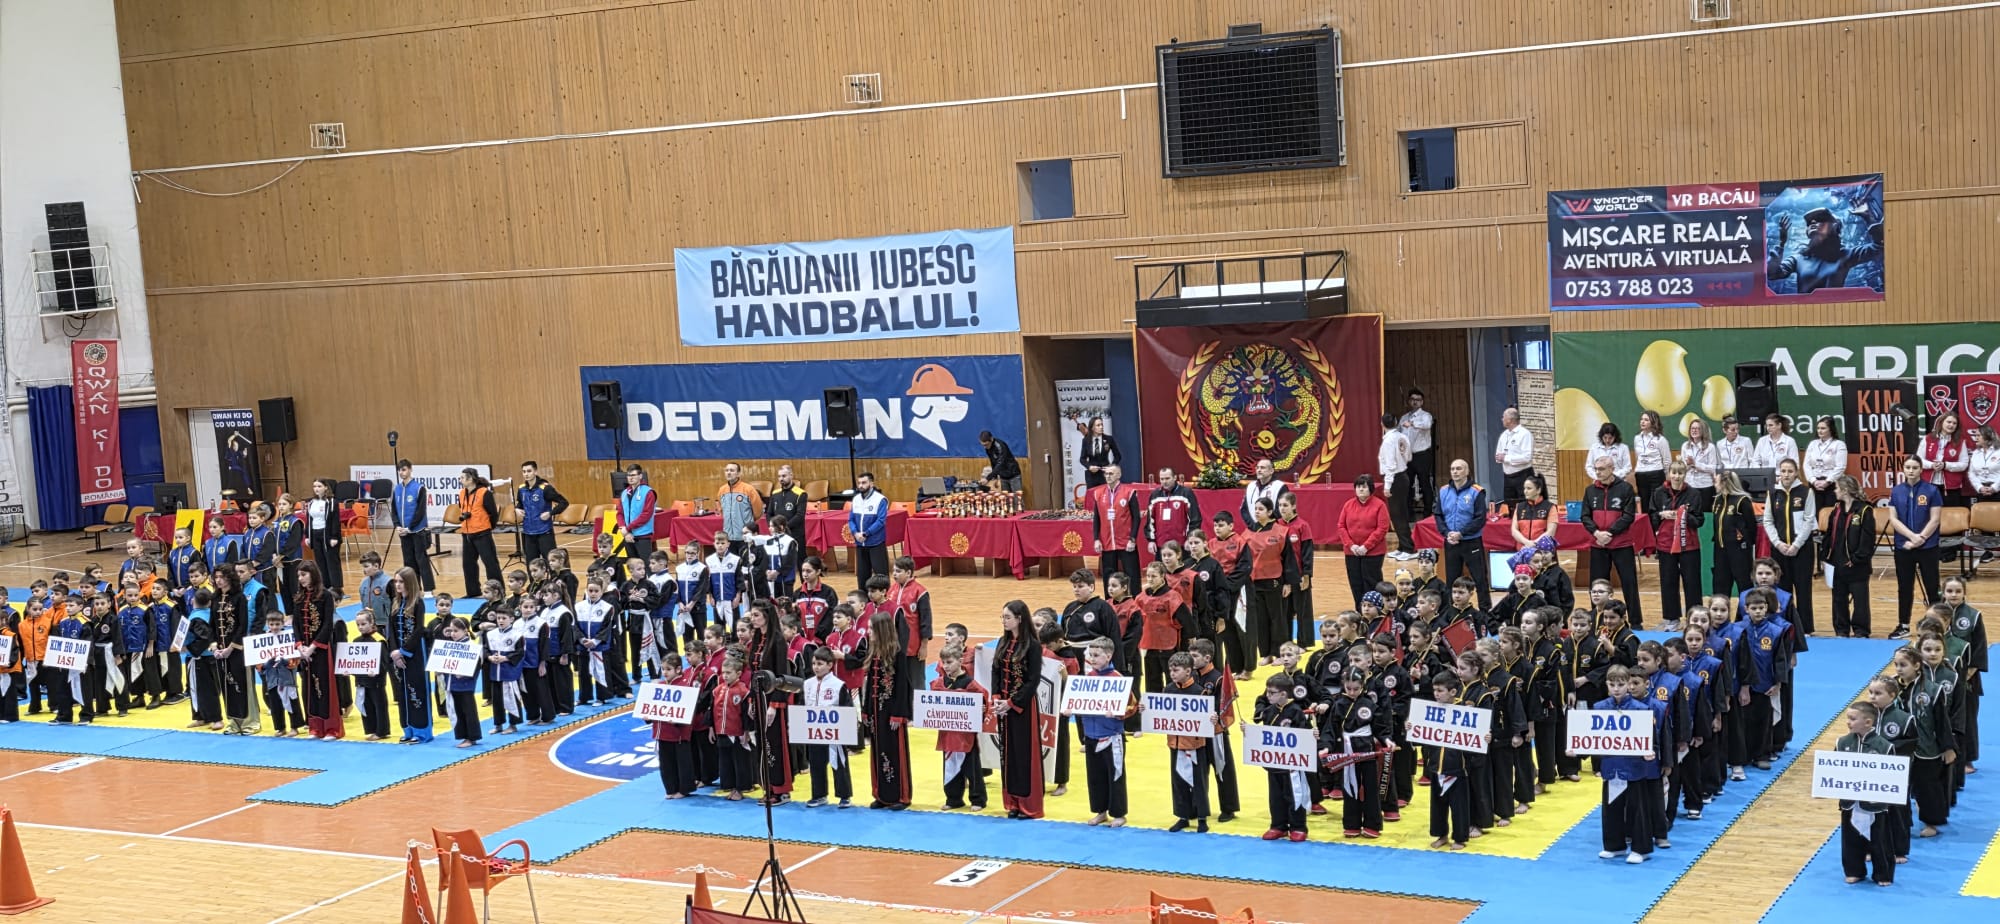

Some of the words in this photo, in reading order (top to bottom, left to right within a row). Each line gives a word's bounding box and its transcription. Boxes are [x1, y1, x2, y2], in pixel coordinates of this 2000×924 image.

[1593, 203, 1639, 212] WORLD
[1672, 193, 1693, 207] VR
[1562, 224, 1666, 250] MIȘCARE
[710, 249, 861, 298] BĂCĂUANII
[871, 243, 976, 291] IUBESC
[1565, 280, 1612, 298] 0753
[1618, 279, 1653, 296] 788
[1658, 278, 1694, 295] 023
[714, 291, 980, 339] HANDBALUL!
[1770, 342, 2000, 396] AGRIC
[84, 366, 111, 415] QWAN
[627, 398, 903, 442] DEDEMN
[1858, 414, 1903, 432] LONG
[92, 429, 109, 452] KI
[94, 466, 112, 488] DO
[1862, 471, 1878, 489] KI
[435, 493, 452, 506] DIN
[253, 636, 274, 648] LUU
[348, 646, 369, 656] CSM
[57, 654, 75, 667] IASI
[1071, 678, 1100, 692] SINH
[1102, 679, 1127, 693] DAU
[652, 688, 682, 703] BAO
[641, 703, 686, 719] BACAU
[1067, 698, 1121, 712] BOTOSANI
[1147, 695, 1177, 712] THOI
[1181, 697, 1209, 713] SON
[806, 709, 840, 724] DAO
[923, 719, 973, 730] MOLDOVENESC
[1425, 705, 1446, 723] HE
[1451, 710, 1479, 729] PAI
[1590, 714, 1632, 731] DAO
[1153, 717, 1201, 733] BRASOV
[807, 727, 839, 741] IASI
[1262, 730, 1298, 748] BAO
[1411, 724, 1482, 749] SUCEAVA
[1571, 735, 1650, 751] BOTOSANI
[1250, 749, 1310, 768] ROMAN
[1818, 758, 1848, 767] BACH
[1852, 760, 1877, 769] UNG
[1880, 762, 1906, 771] DAO
[1820, 777, 1900, 793] Marginea
[949, 868, 987, 883] 3
